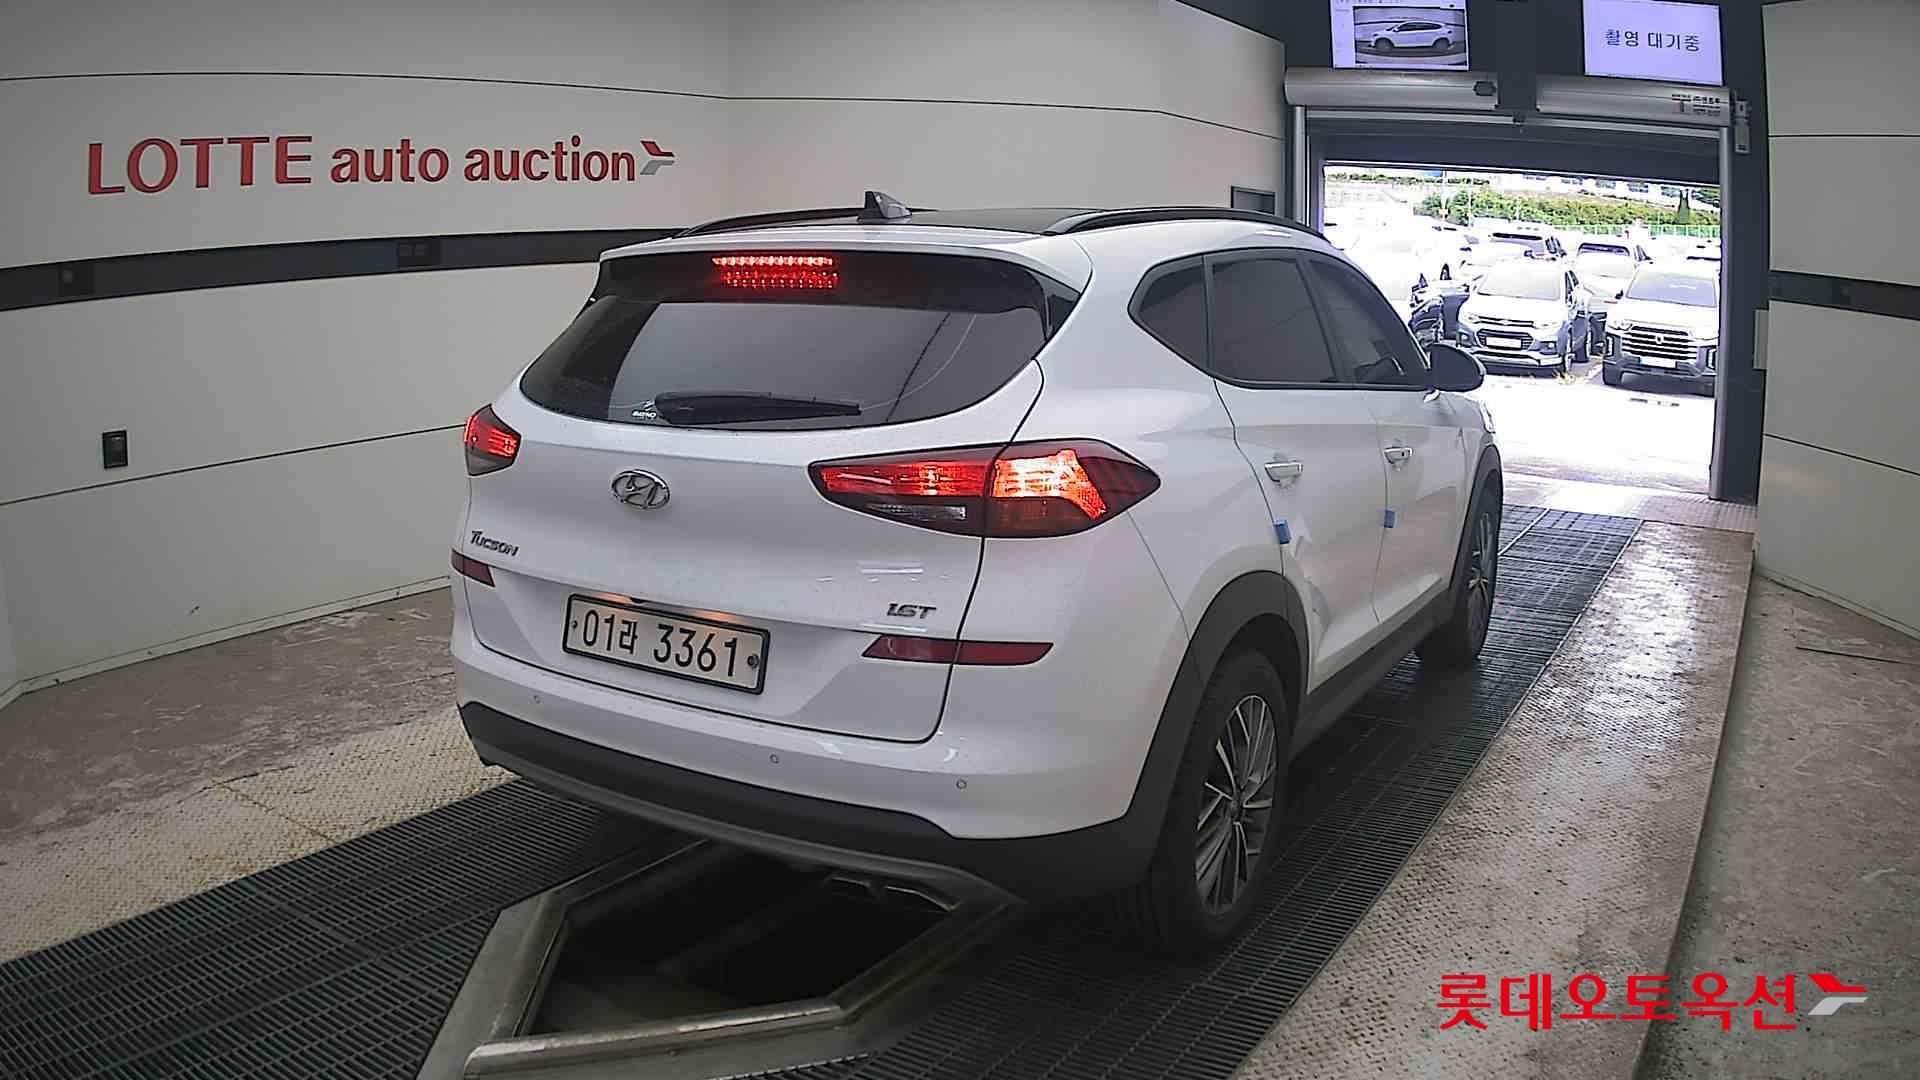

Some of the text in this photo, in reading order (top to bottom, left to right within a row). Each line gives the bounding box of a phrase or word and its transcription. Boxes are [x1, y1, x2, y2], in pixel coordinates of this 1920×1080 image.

[1648, 32, 1700, 52] 대기중
[89, 136, 637, 195] LOTTE auto auction
[583, 609, 738, 677] 01라 3361
